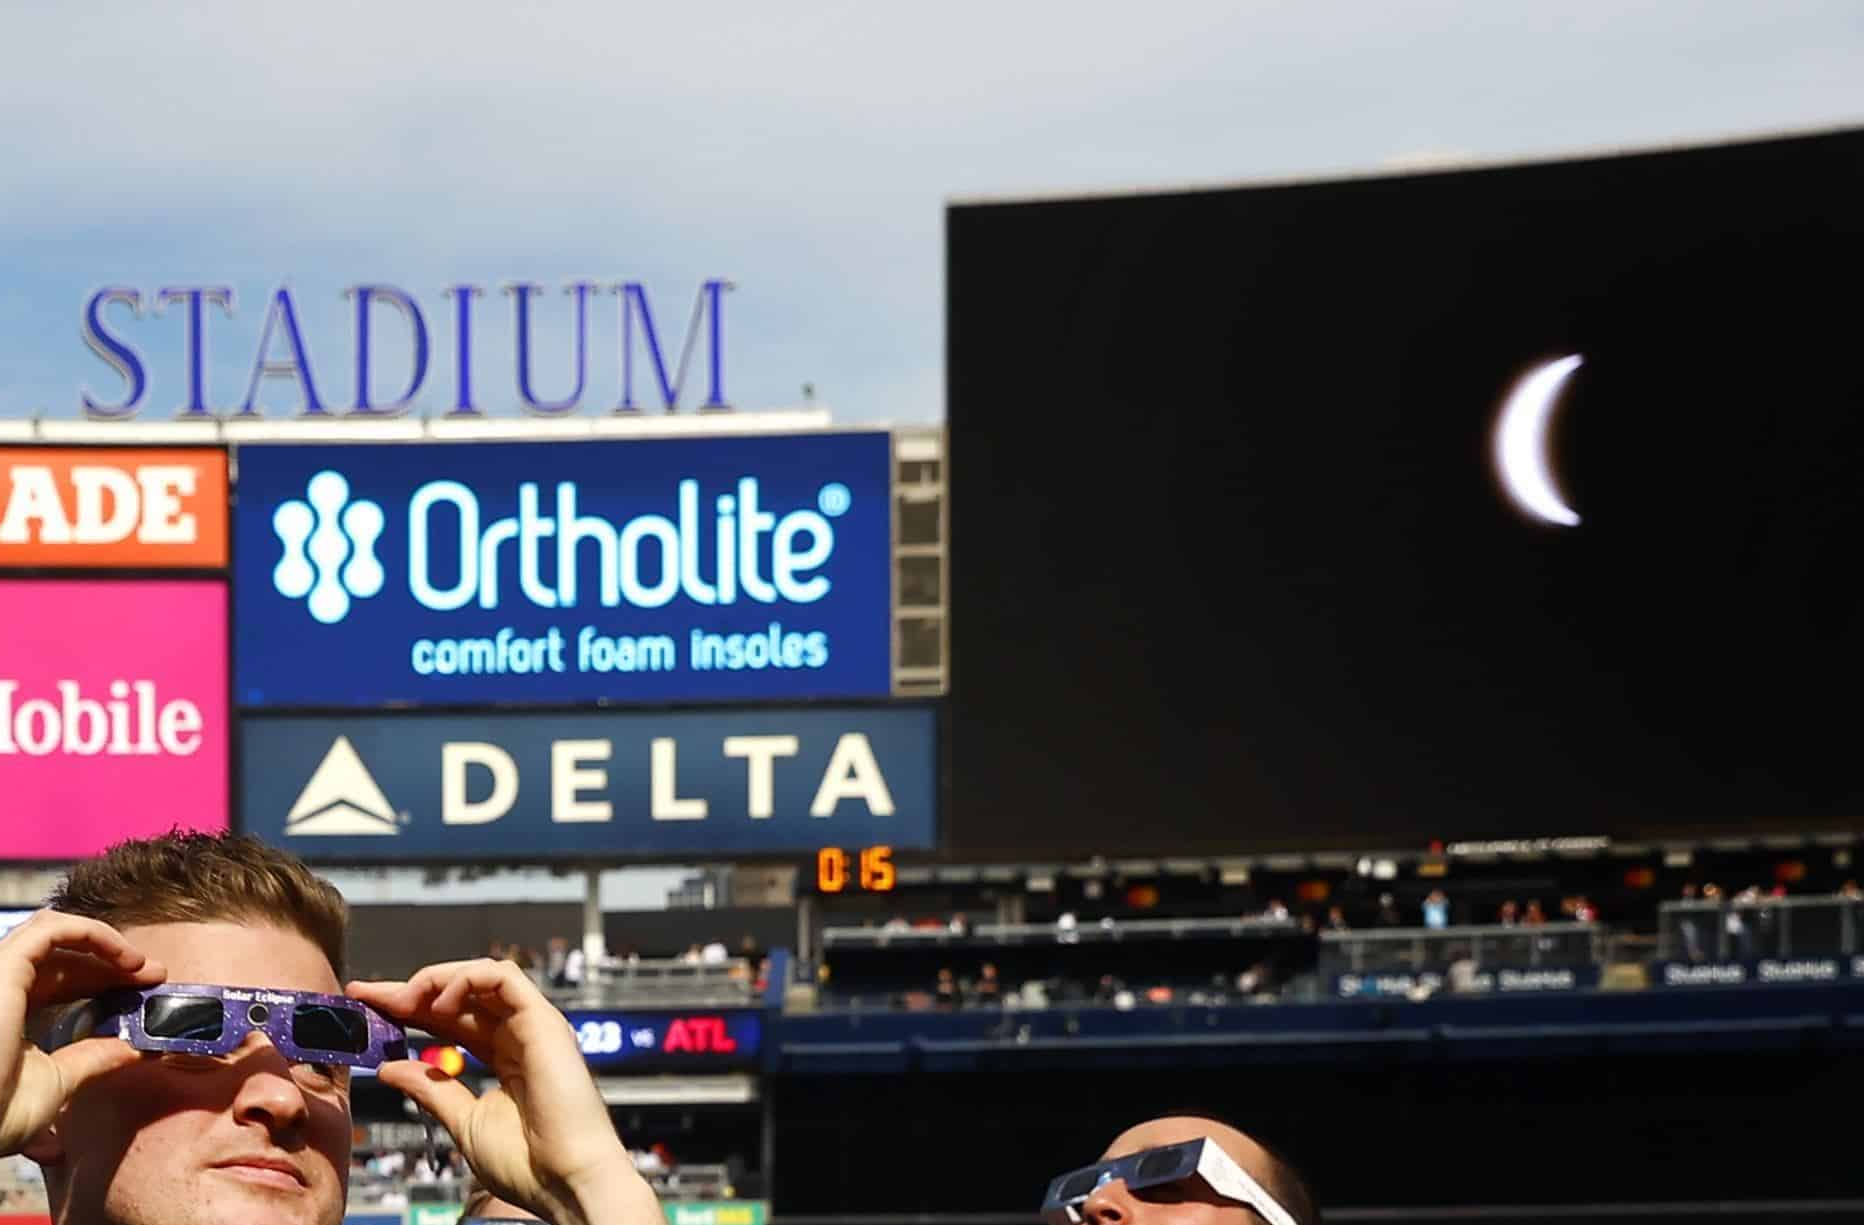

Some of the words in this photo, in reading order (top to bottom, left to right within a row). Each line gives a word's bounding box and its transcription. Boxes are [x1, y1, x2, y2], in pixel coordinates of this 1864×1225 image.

[81, 278, 735, 420] STADIUM
[412, 628, 566, 675] comfort
[578, 626, 676, 672] foam
[690, 622, 829, 669] insoles
[441, 733, 896, 826] DELTA
[662, 1016, 738, 1055] ATL
